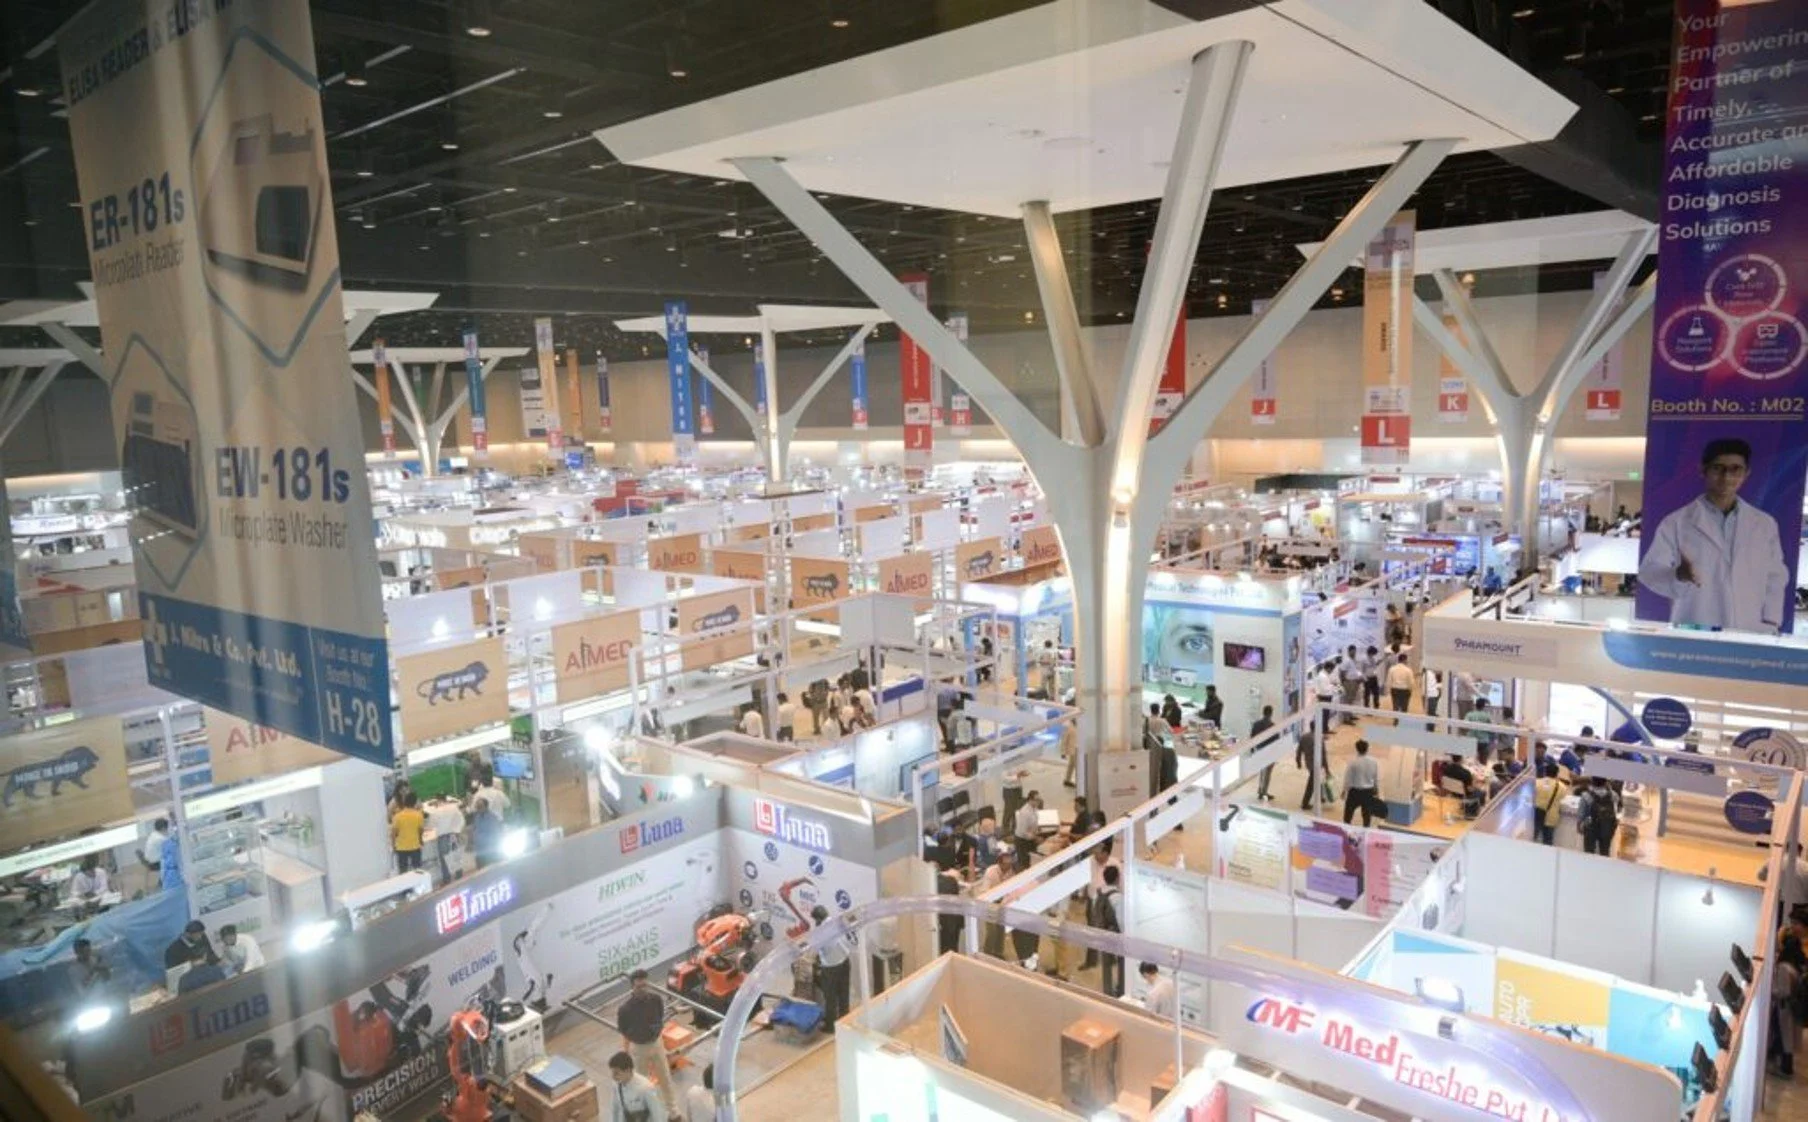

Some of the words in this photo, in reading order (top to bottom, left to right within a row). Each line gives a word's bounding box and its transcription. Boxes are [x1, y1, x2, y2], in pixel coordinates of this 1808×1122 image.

[1677, 13, 1730, 33] Your
[1674, 67, 1763, 93] Partner
[1769, 60, 1794, 79] of
[1673, 99, 1753, 123] Timely,
[1670, 128, 1774, 152] Accurate
[1668, 154, 1794, 182] Affordable
[90, 170, 184, 252] ER-181s
[1667, 185, 1781, 212] Diagnosis
[1665, 217, 1772, 241] Solutions
[1259, 401, 1268, 414] J
[1447, 396, 1460, 410] K
[1598, 393, 1609, 408] L
[1651, 398, 1707, 413] Booth
[1761, 397, 1805, 412] M02
[912, 428, 923, 447] J
[1378, 419, 1395, 444] L
[216, 446, 351, 504] EW-181s
[288, 510, 348, 550] Washer
[1453, 637, 1522, 657] PARAMOUNT
[275, 648, 303, 678] Ltd.
[325, 690, 382, 747] H-28
[640, 816, 684, 848] Luna
[448, 950, 498, 986] WELDING
[190, 991, 270, 1040] Luna
[352, 1048, 437, 1111] PRECISION
